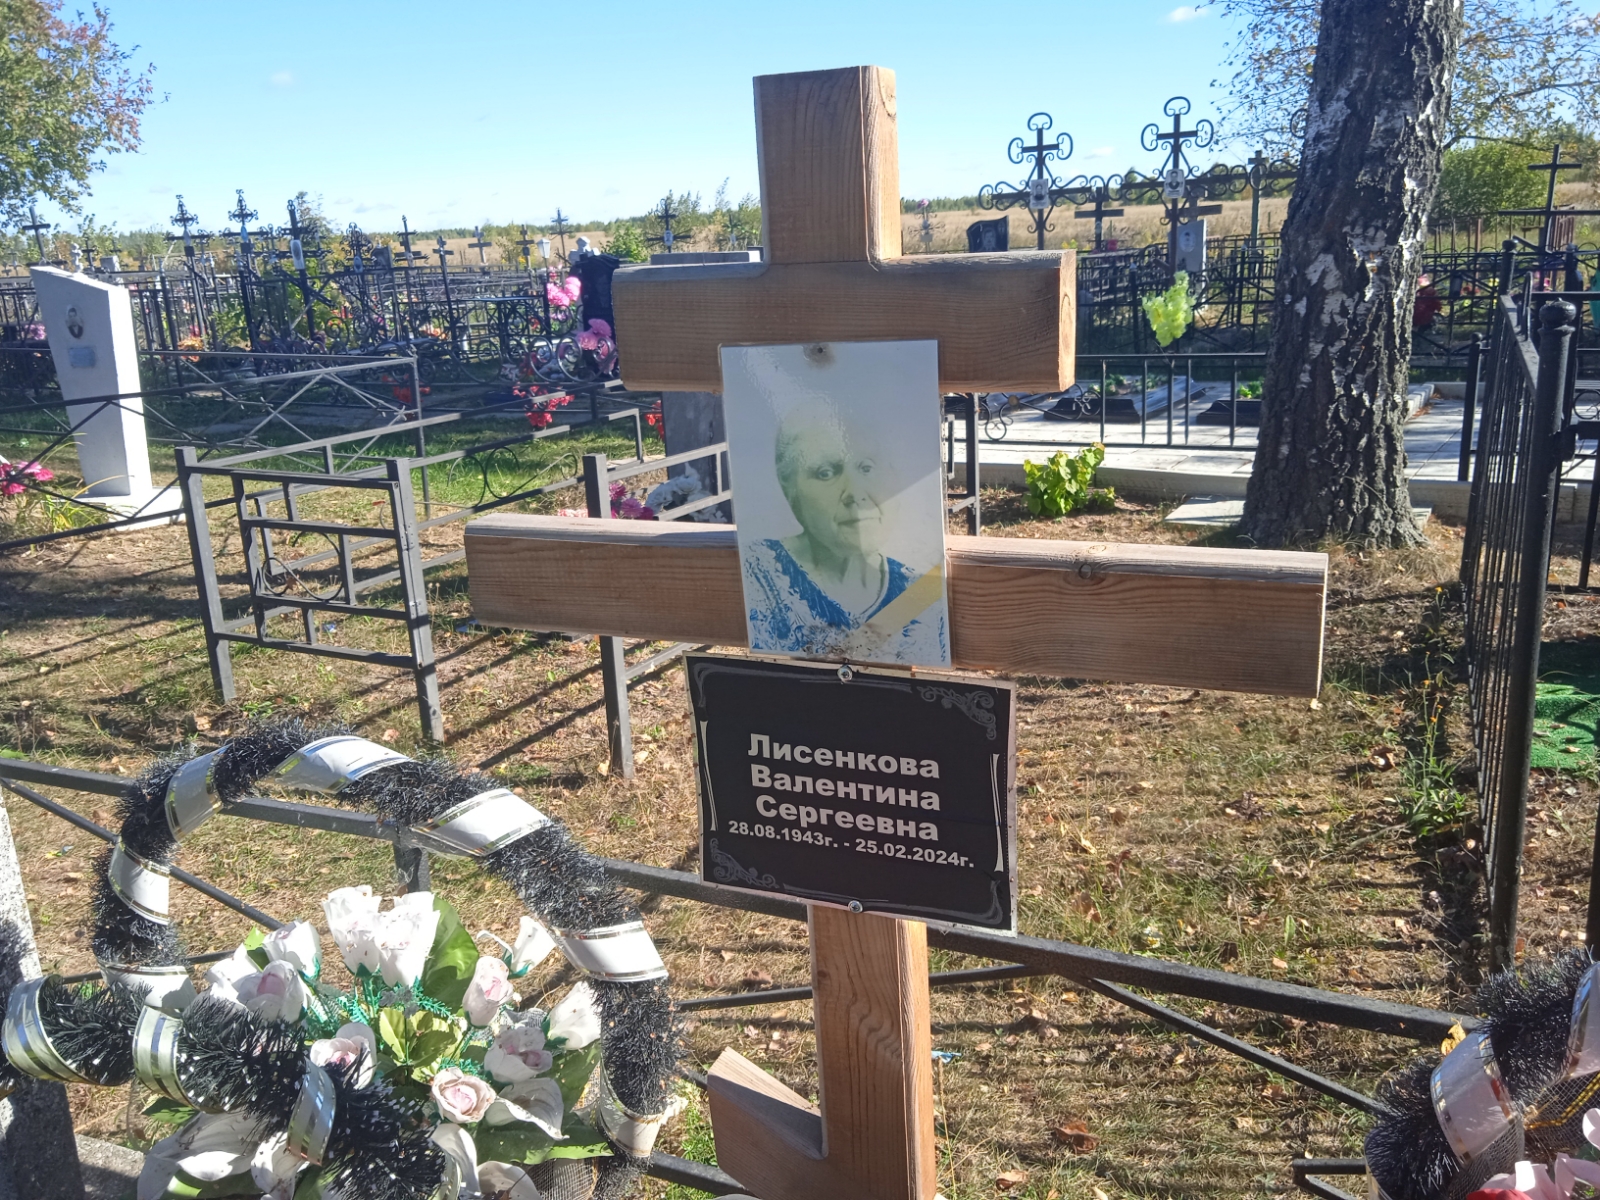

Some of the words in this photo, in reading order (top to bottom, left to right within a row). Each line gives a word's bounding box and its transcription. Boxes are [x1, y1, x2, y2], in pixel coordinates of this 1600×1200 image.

[748, 733, 940, 779] Лисенкова
[751, 764, 940, 811] Валентина
[755, 795, 939, 841] Сергеевна
[728, 820, 838, 848] 28.08.1943г.
[856, 839, 975, 868] 25.02.2024г.
